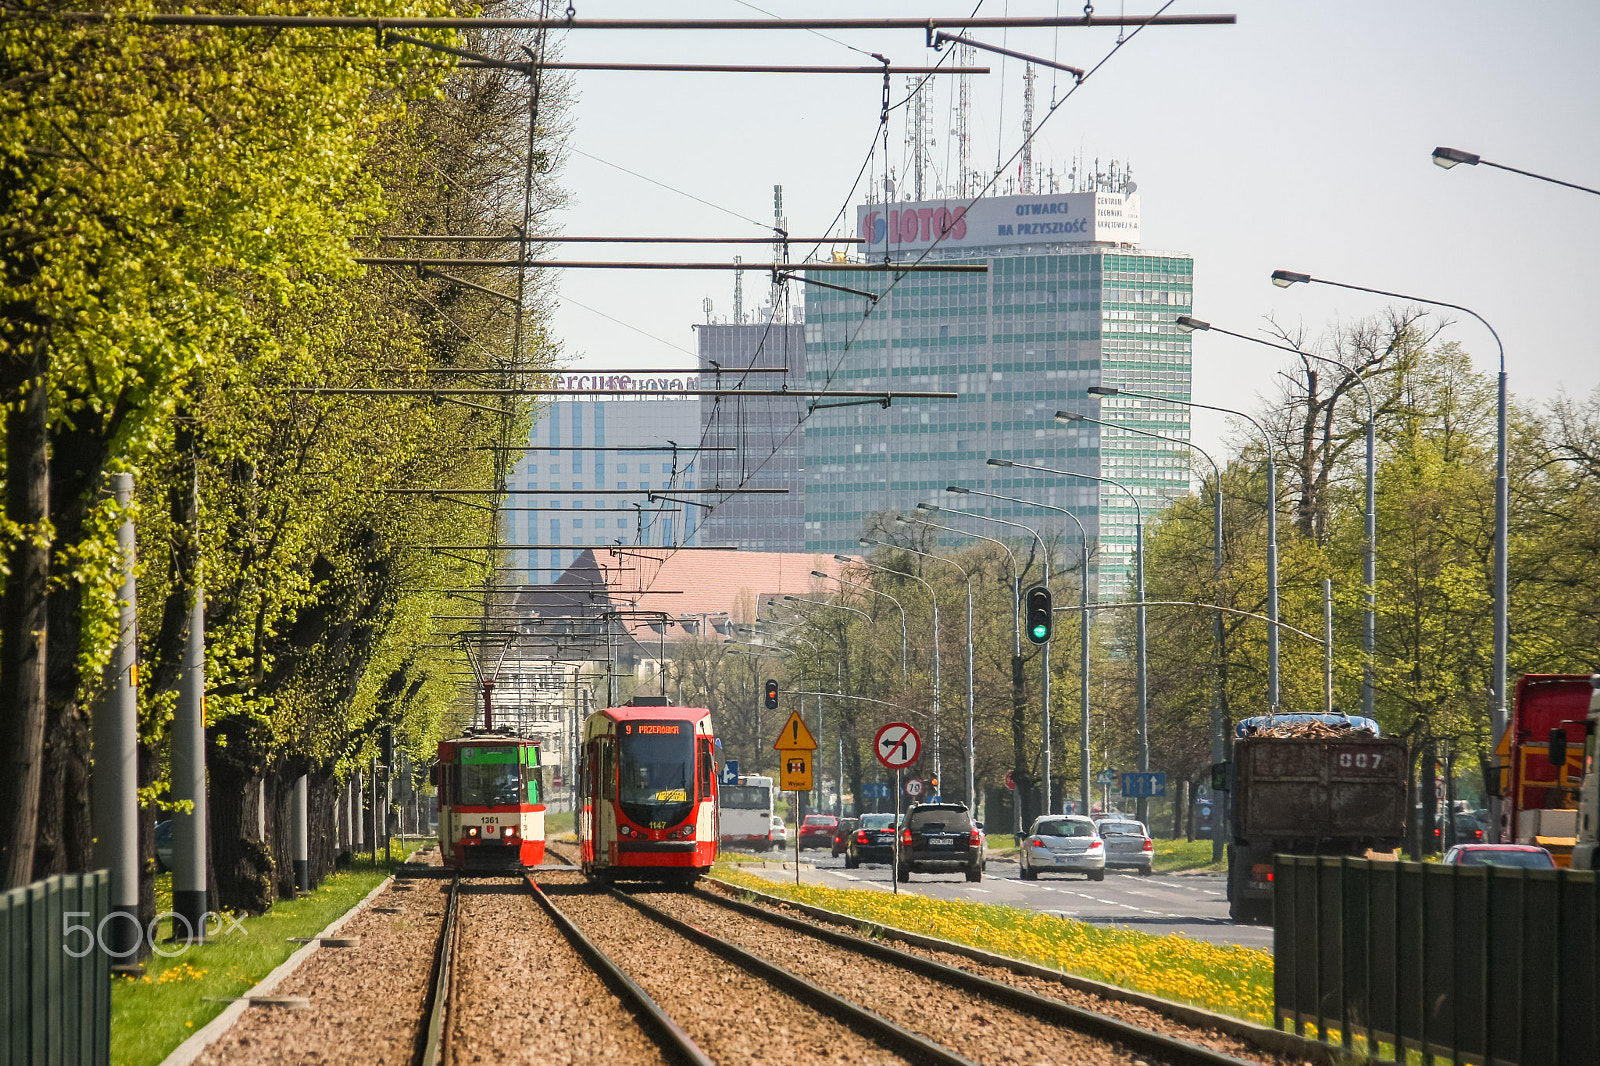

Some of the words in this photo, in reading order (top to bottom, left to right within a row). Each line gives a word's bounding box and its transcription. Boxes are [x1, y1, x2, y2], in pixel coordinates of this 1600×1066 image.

[1015, 202, 1068, 216] OTWARCI
[889, 206, 967, 244] LOTOS
[997, 224, 1014, 236] NA
[1017, 218, 1088, 235] PRZYSZŁOŚĆ
[625, 724, 632, 735] 9
[1339, 753, 1382, 769] 007
[908, 783, 921, 793] 70
[480, 816, 499, 824] 1361
[648, 821, 667, 830] 1147
